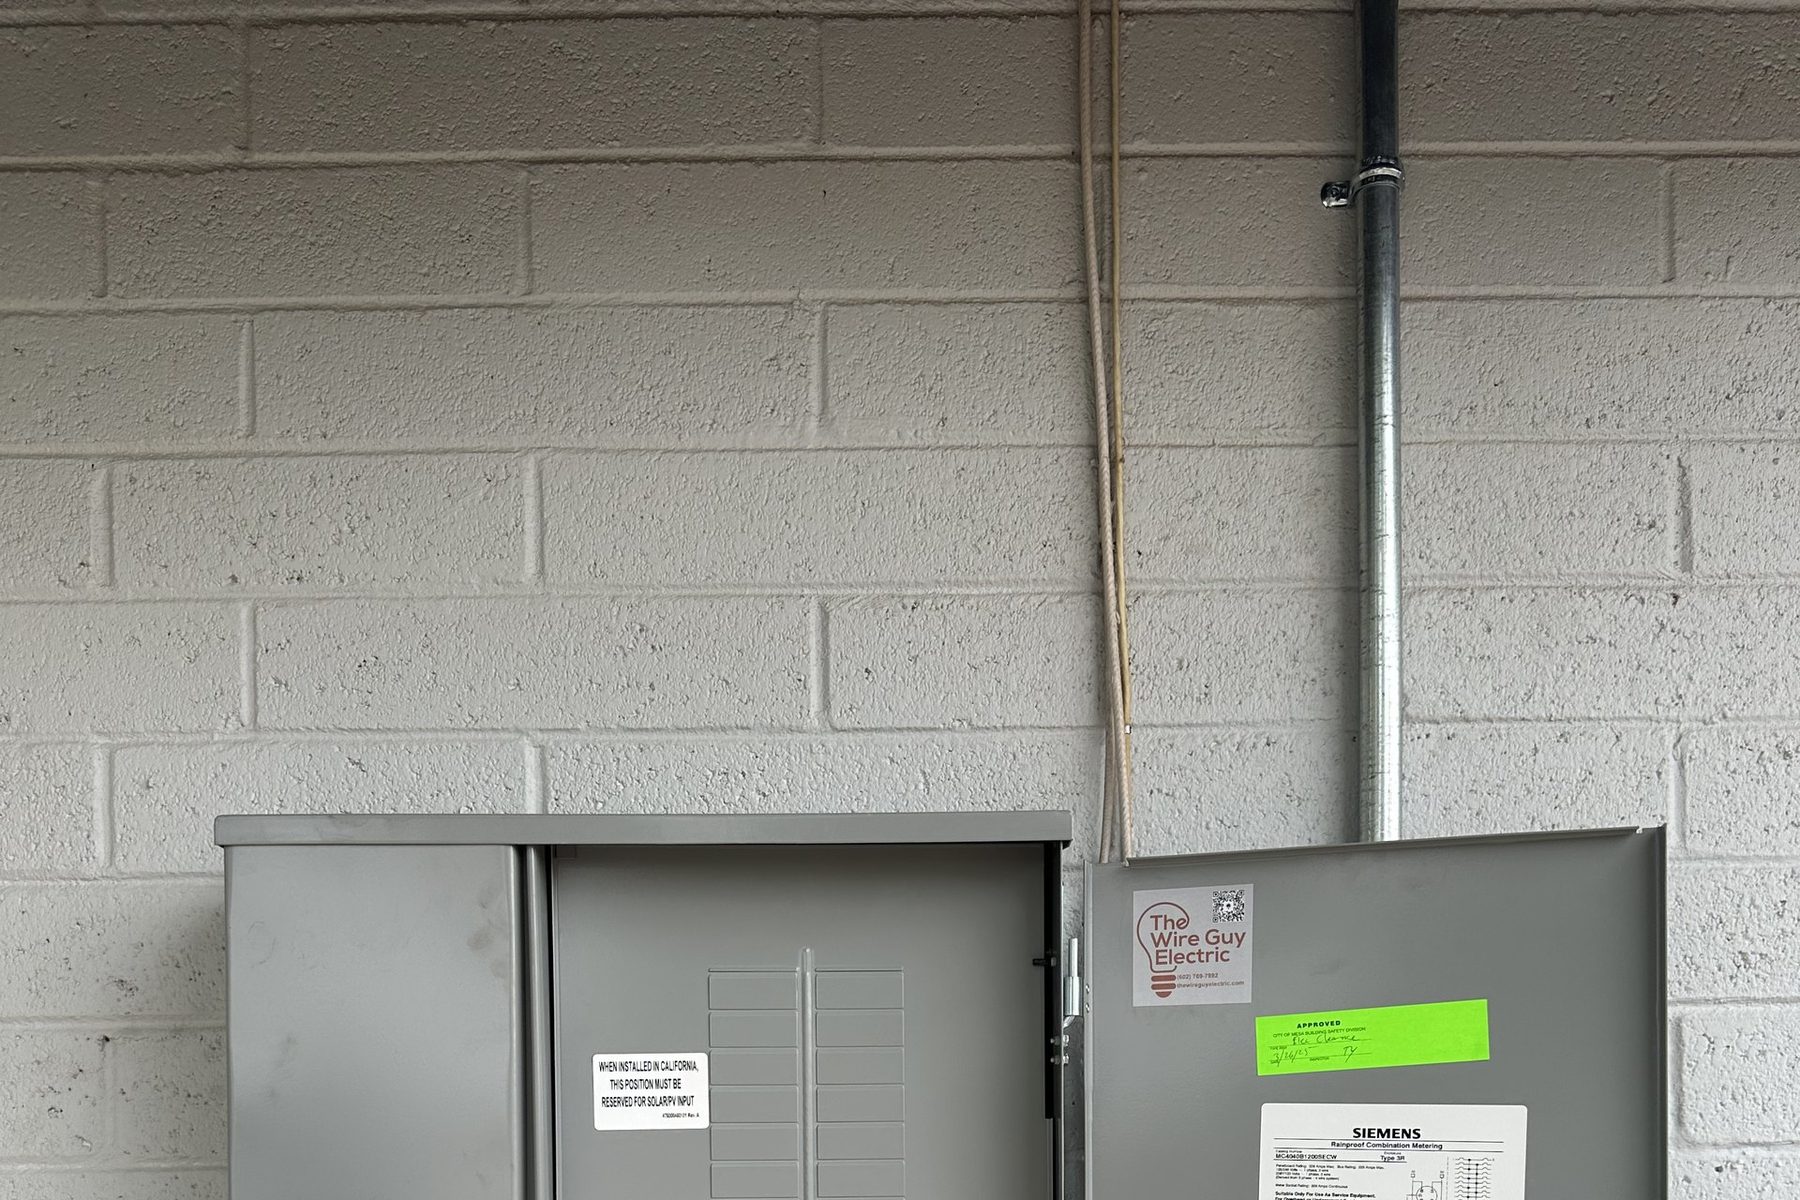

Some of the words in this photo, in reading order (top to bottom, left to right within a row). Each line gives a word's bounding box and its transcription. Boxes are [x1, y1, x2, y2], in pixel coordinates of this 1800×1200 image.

[1150, 914, 1190, 931] The
[1150, 931, 1200, 948] Wire
[1205, 928, 1246, 948] Guy
[1155, 947, 1230, 965] Electric
[1296, 1020, 1342, 1029] APPROVED
[599, 1061, 618, 1072] WHEN
[618, 1060, 651, 1072] INSTALLED
[653, 1060, 660, 1071] IN
[660, 1060, 699, 1072] CALIFORNIA,
[610, 1079, 624, 1090] THIS
[624, 1078, 654, 1090] POSITION
[655, 1078, 672, 1090] MUST
[673, 1078, 682, 1089] BE
[601, 1096, 633, 1108] RESERVED
[634, 1096, 646, 1107] FOR
[647, 1095, 676, 1107] SOLAR/PV
[677, 1095, 695, 1107] INPUT
[1352, 1127, 1422, 1140] SIEMENS
[1331, 1141, 1365, 1150] Rainproof
[1366, 1141, 1411, 1149] Combination
[1412, 1142, 1443, 1151] Metering
